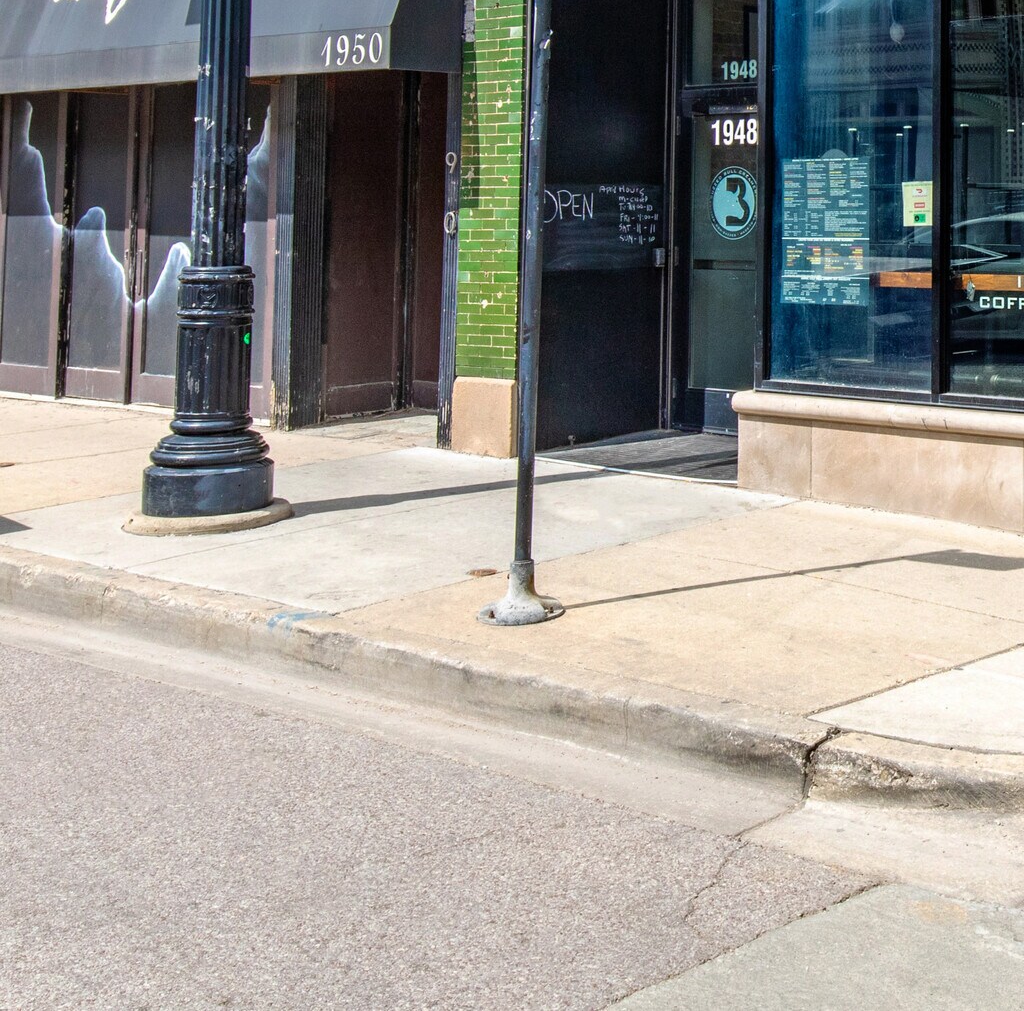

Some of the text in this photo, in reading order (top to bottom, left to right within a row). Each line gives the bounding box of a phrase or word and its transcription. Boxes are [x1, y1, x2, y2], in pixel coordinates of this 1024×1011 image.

[321, 32, 382, 67] 1950
[721, 59, 757, 80] 1948
[711, 118, 758, 145] 1948
